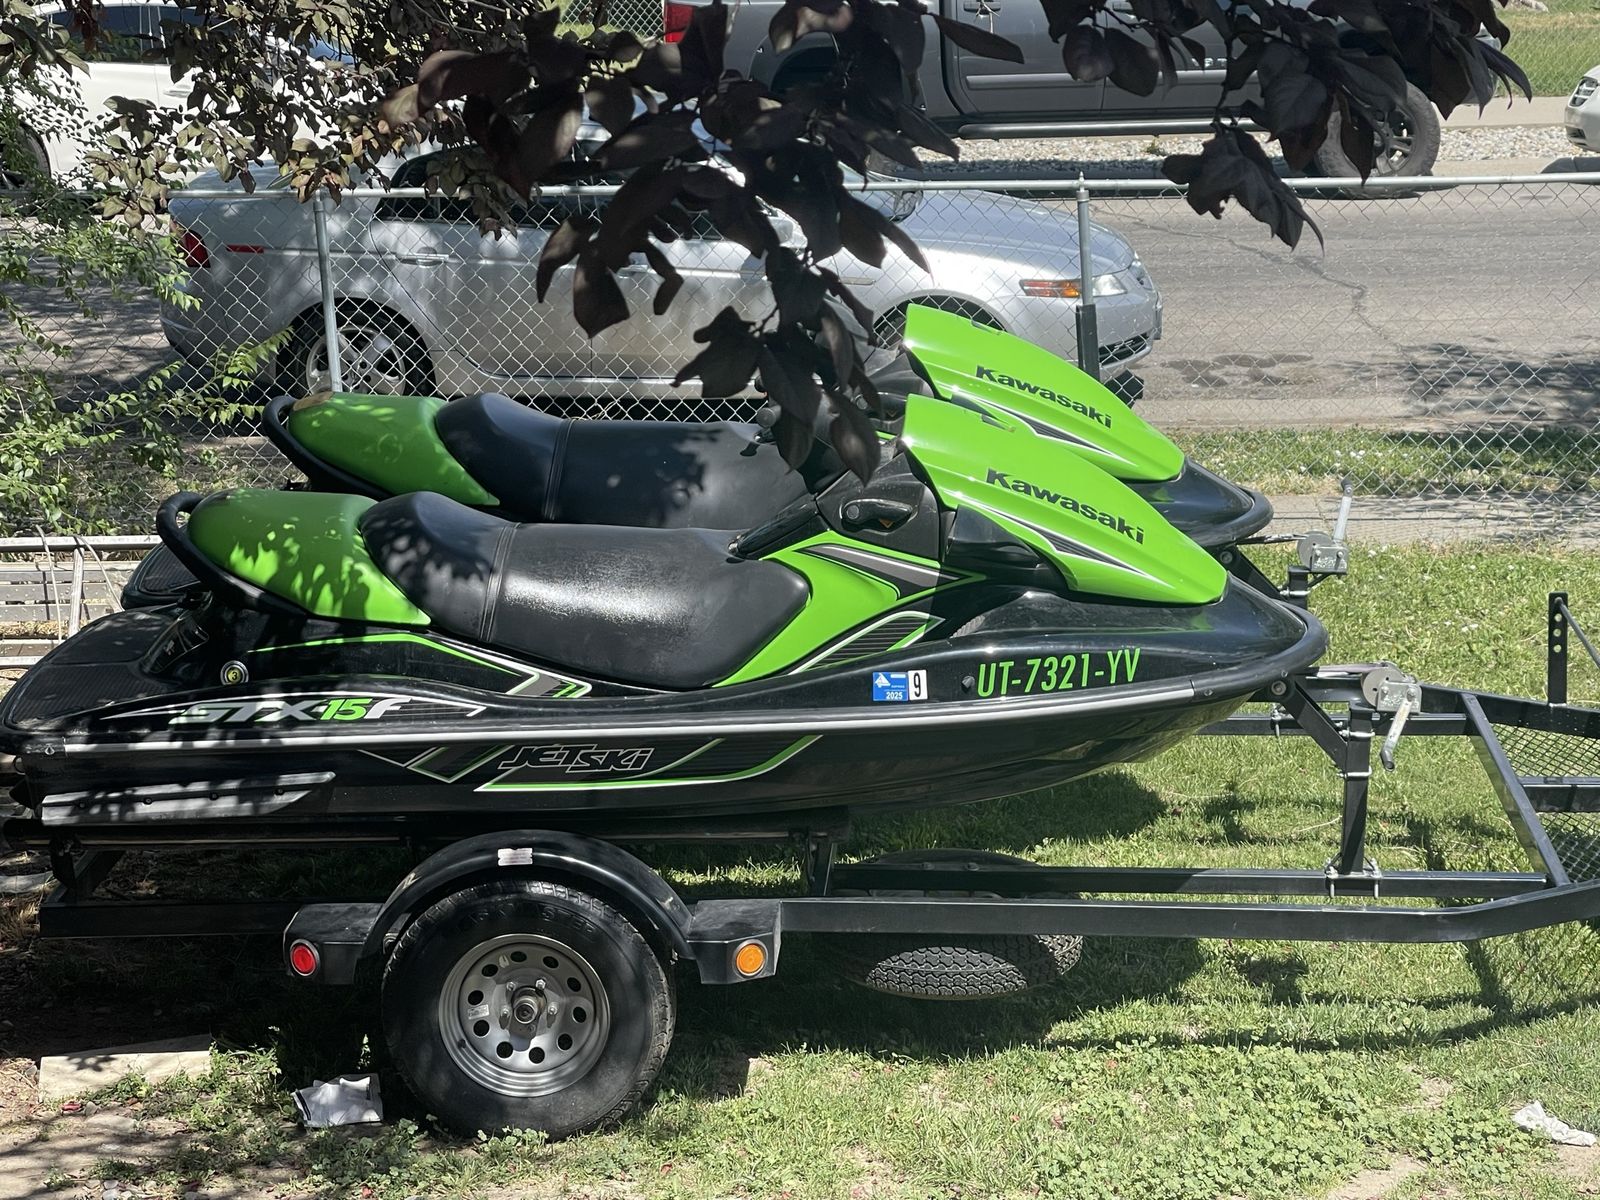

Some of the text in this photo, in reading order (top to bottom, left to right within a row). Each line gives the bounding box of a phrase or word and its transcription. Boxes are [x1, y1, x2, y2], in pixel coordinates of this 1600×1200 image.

[976, 366, 1112, 428] Kawasaki
[986, 468, 1145, 545] Kawasaki
[886, 691, 903, 700] 2025
[913, 672, 921, 697] 9
[977, 647, 1141, 697] UT-7321-YV
